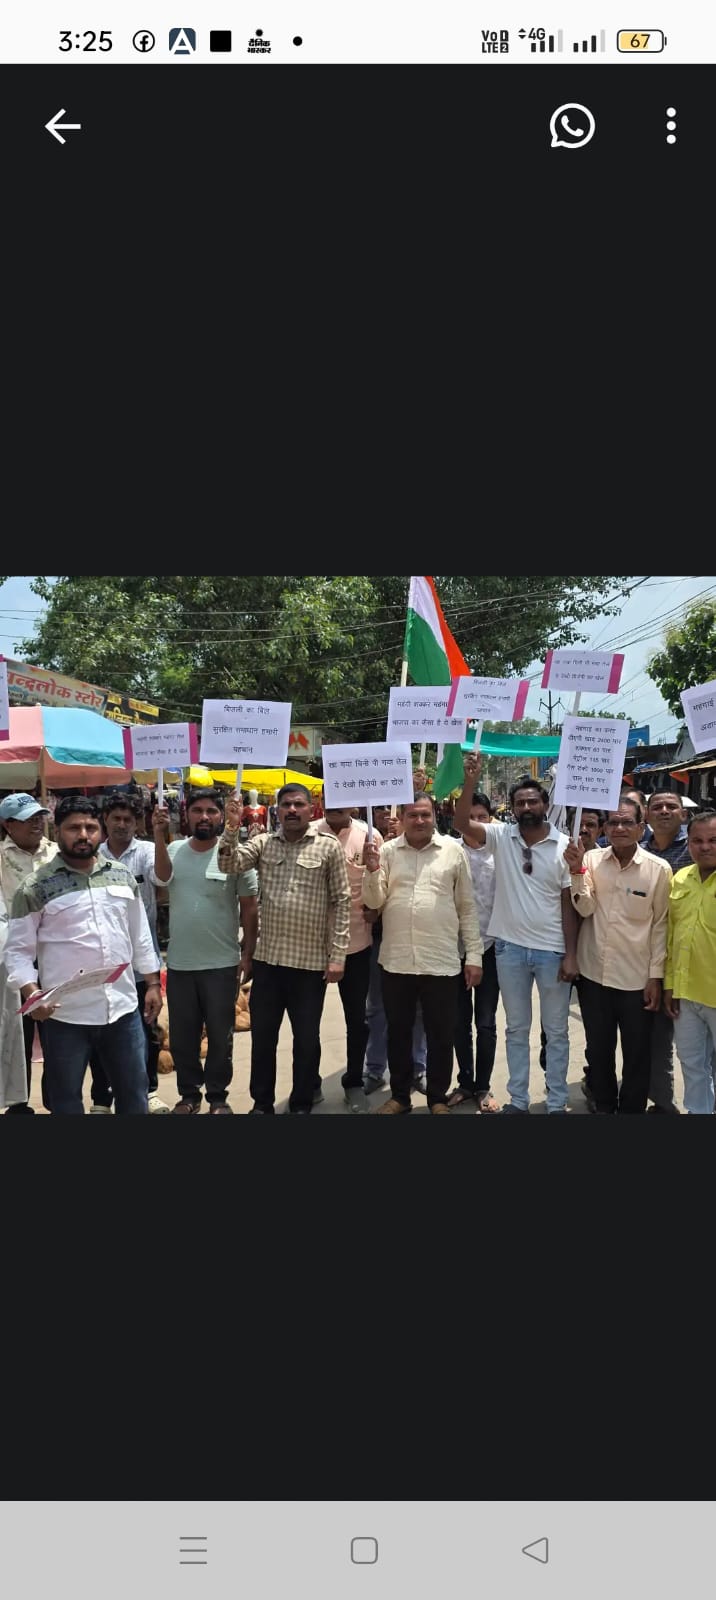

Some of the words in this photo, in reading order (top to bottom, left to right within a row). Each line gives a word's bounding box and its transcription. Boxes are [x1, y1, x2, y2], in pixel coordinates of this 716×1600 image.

[528, 28, 546, 40] 4G
[630, 33, 650, 48] 67
[58, 31, 113, 52] 3:25
[482, 42, 499, 53] LTE
[74, 690, 105, 707] स्टोर
[223, 704, 243, 713] बिजली
[257, 705, 270, 714] बिल
